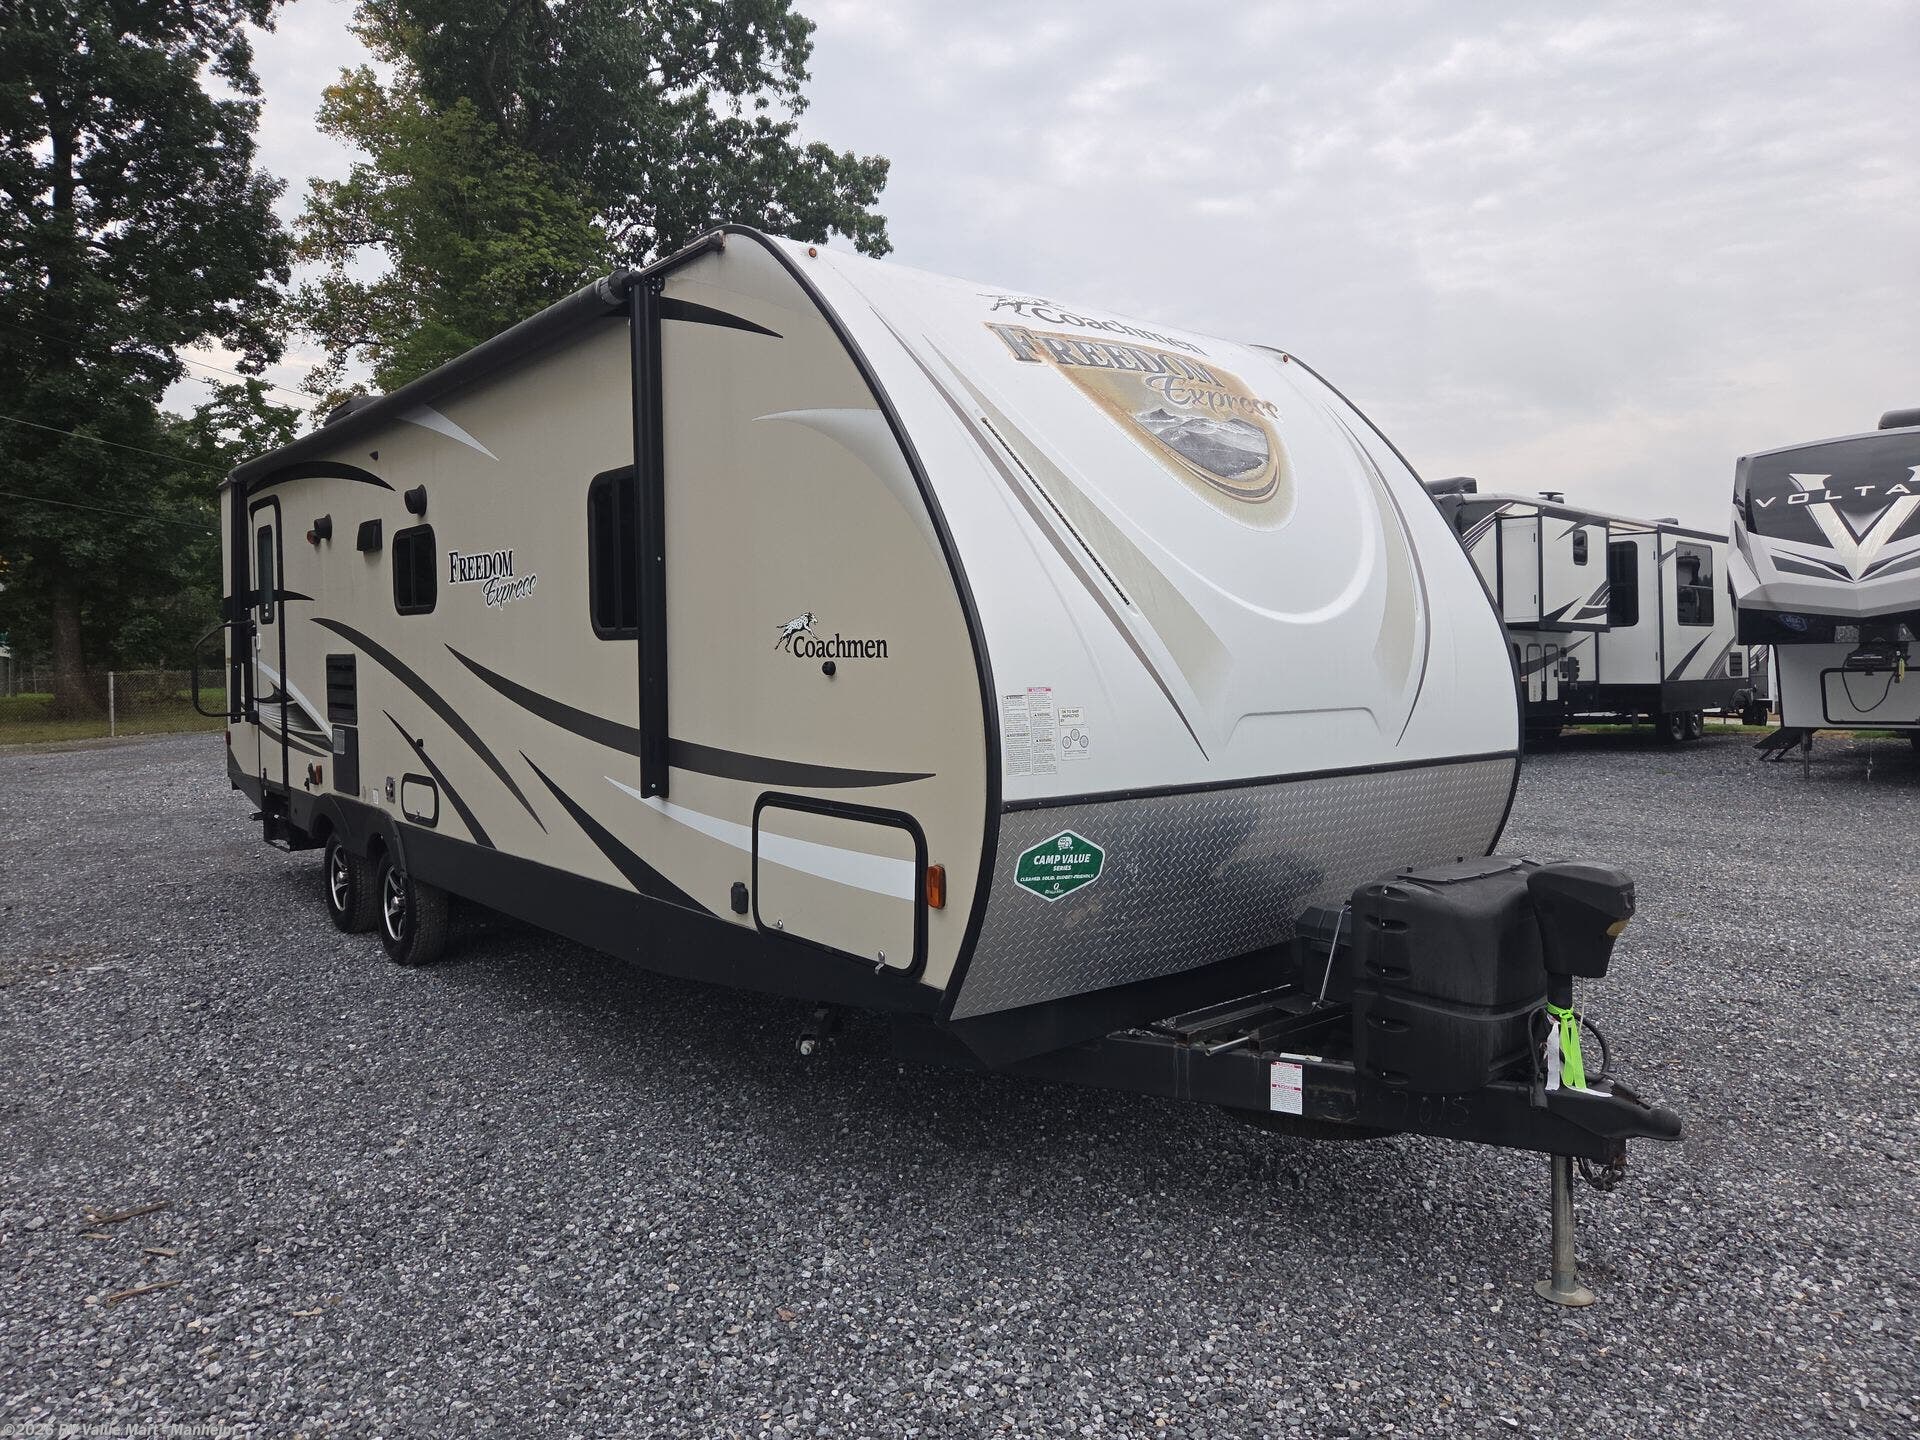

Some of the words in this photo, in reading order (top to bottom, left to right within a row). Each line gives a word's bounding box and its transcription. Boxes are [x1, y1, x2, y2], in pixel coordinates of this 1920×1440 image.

[1031, 306, 1209, 357] Coachmen
[984, 321, 1225, 389] FREEDOM
[1145, 374, 1280, 420] Express
[1755, 482, 1912, 509] VOLTA
[448, 550, 514, 584] FREEDOM
[482, 574, 537, 610] Express
[793, 632, 889, 659] Coachmen
[1033, 854, 1061, 865] CAMP
[1062, 853, 1092, 864] VALUE
